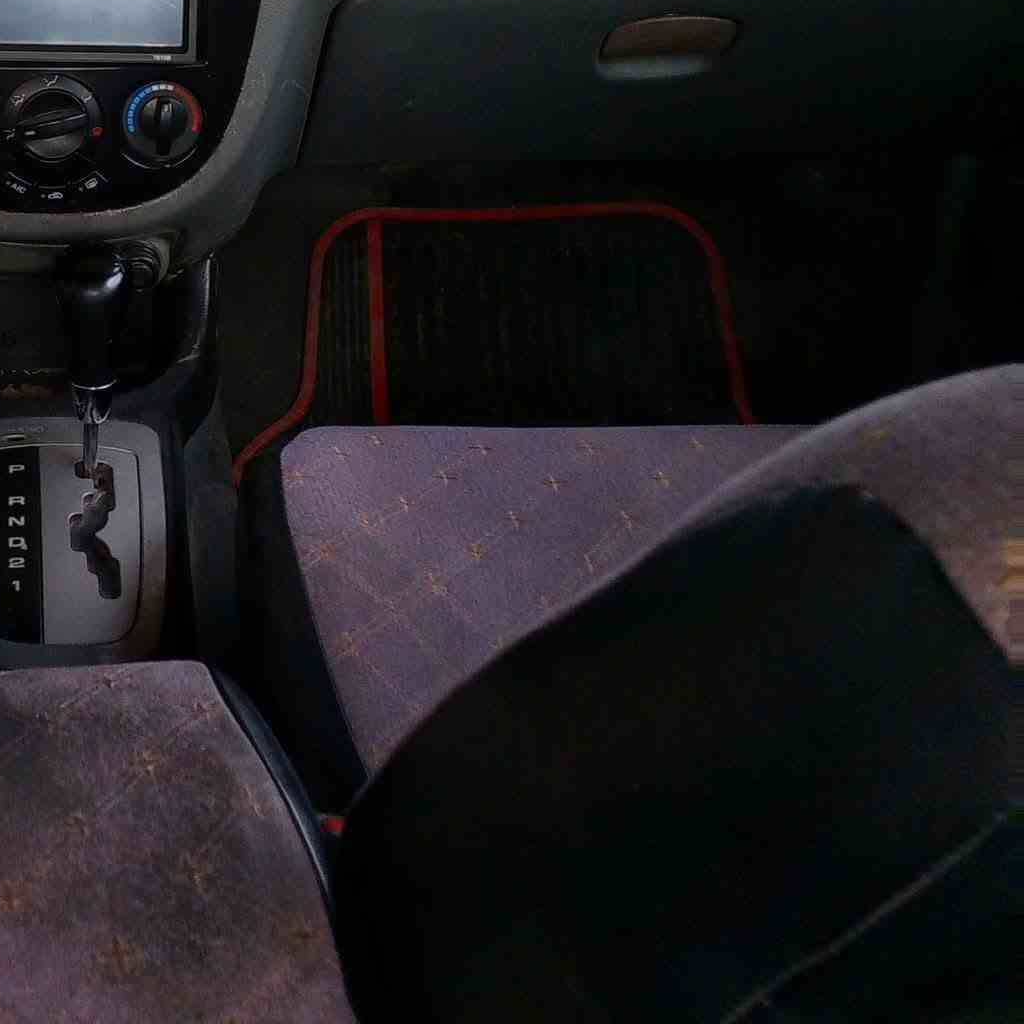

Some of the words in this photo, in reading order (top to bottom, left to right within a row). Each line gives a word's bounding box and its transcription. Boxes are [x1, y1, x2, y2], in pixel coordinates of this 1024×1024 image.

[8, 464, 25, 474] P
[8, 496, 25, 506] R
[8, 517, 25, 527] N
[8, 557, 25, 569] 2
[12, 580, 20, 592] 1
